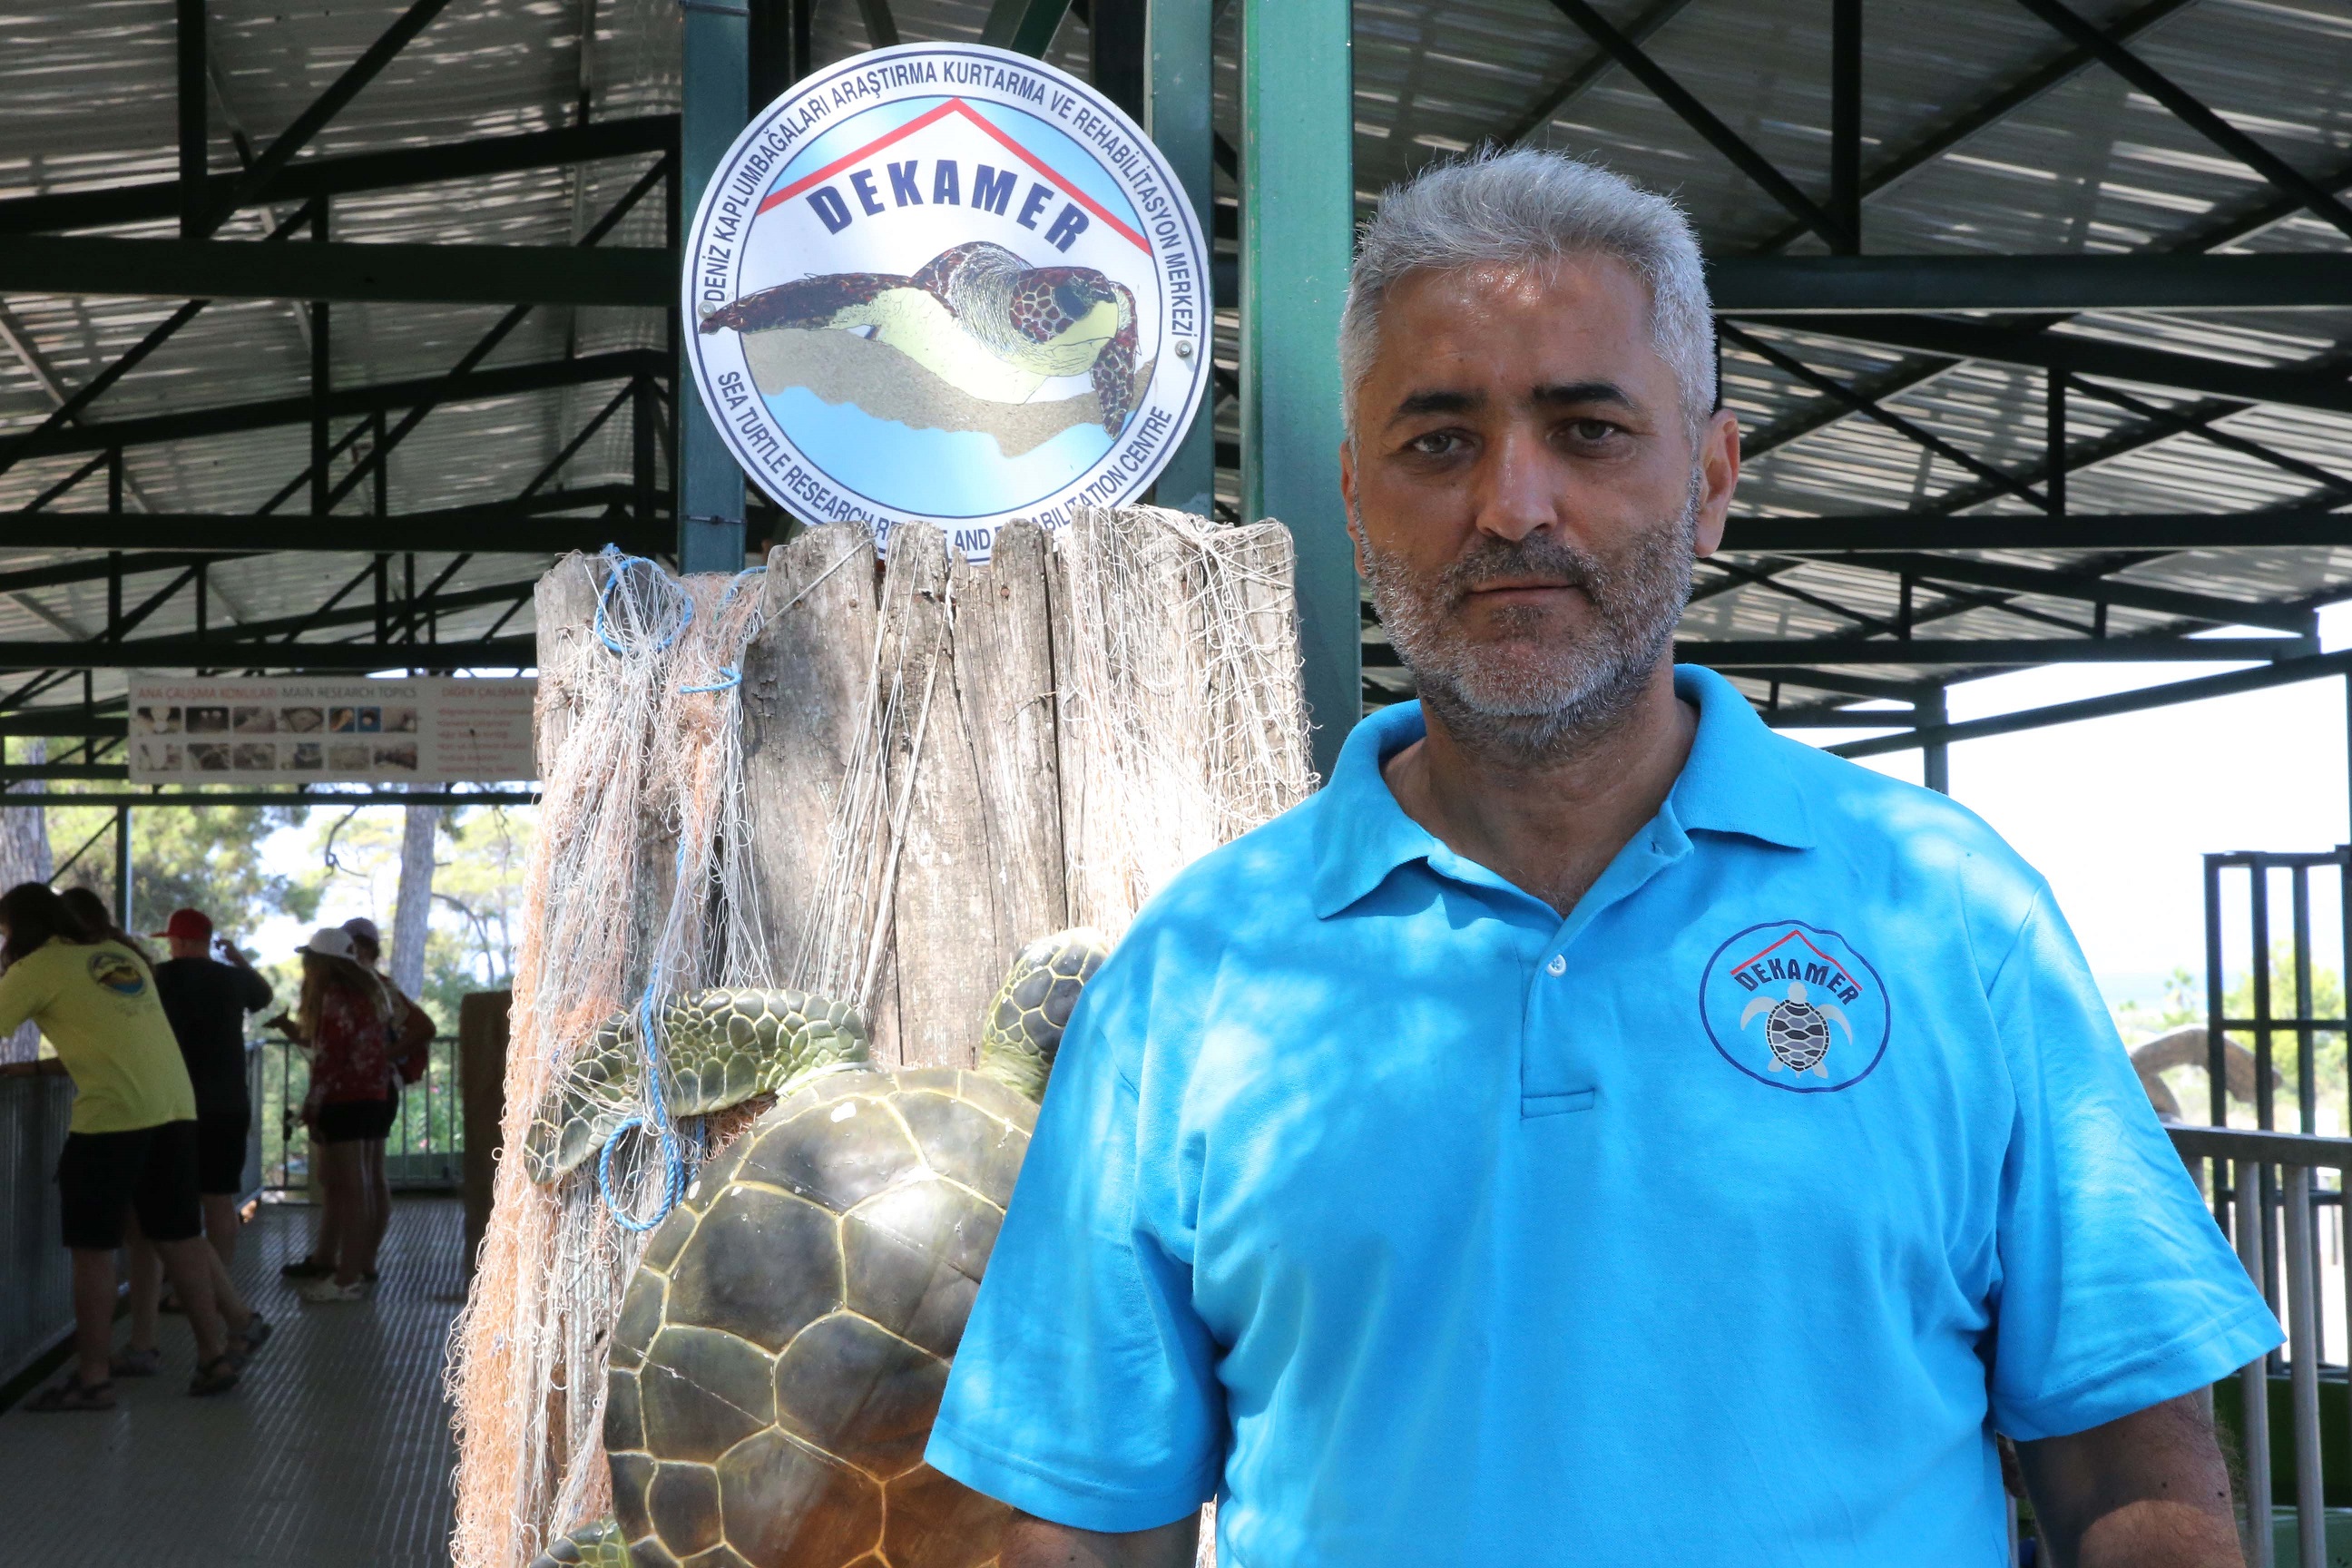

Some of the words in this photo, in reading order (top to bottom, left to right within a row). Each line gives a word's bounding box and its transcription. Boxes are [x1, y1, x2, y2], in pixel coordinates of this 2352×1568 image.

[831, 62, 937, 108] ARAŞTIRMA
[944, 61, 1045, 105] KURTARMA
[1050, 90, 1076, 120] VE
[713, 94, 831, 243] KAPLUMBAĞALARI
[1073, 107, 1182, 250] REHABİLİTASYON
[806, 159, 1090, 253] DEKAMER
[702, 240, 731, 302] DENİZ
[1164, 252, 1198, 338] MERKEZİ
[718, 371, 749, 410] SEA
[736, 407, 791, 474] TURTLE
[955, 528, 991, 551] AND
[1120, 406, 1172, 472] CENTRE
[1734, 957, 1859, 1005] DEKAMER
